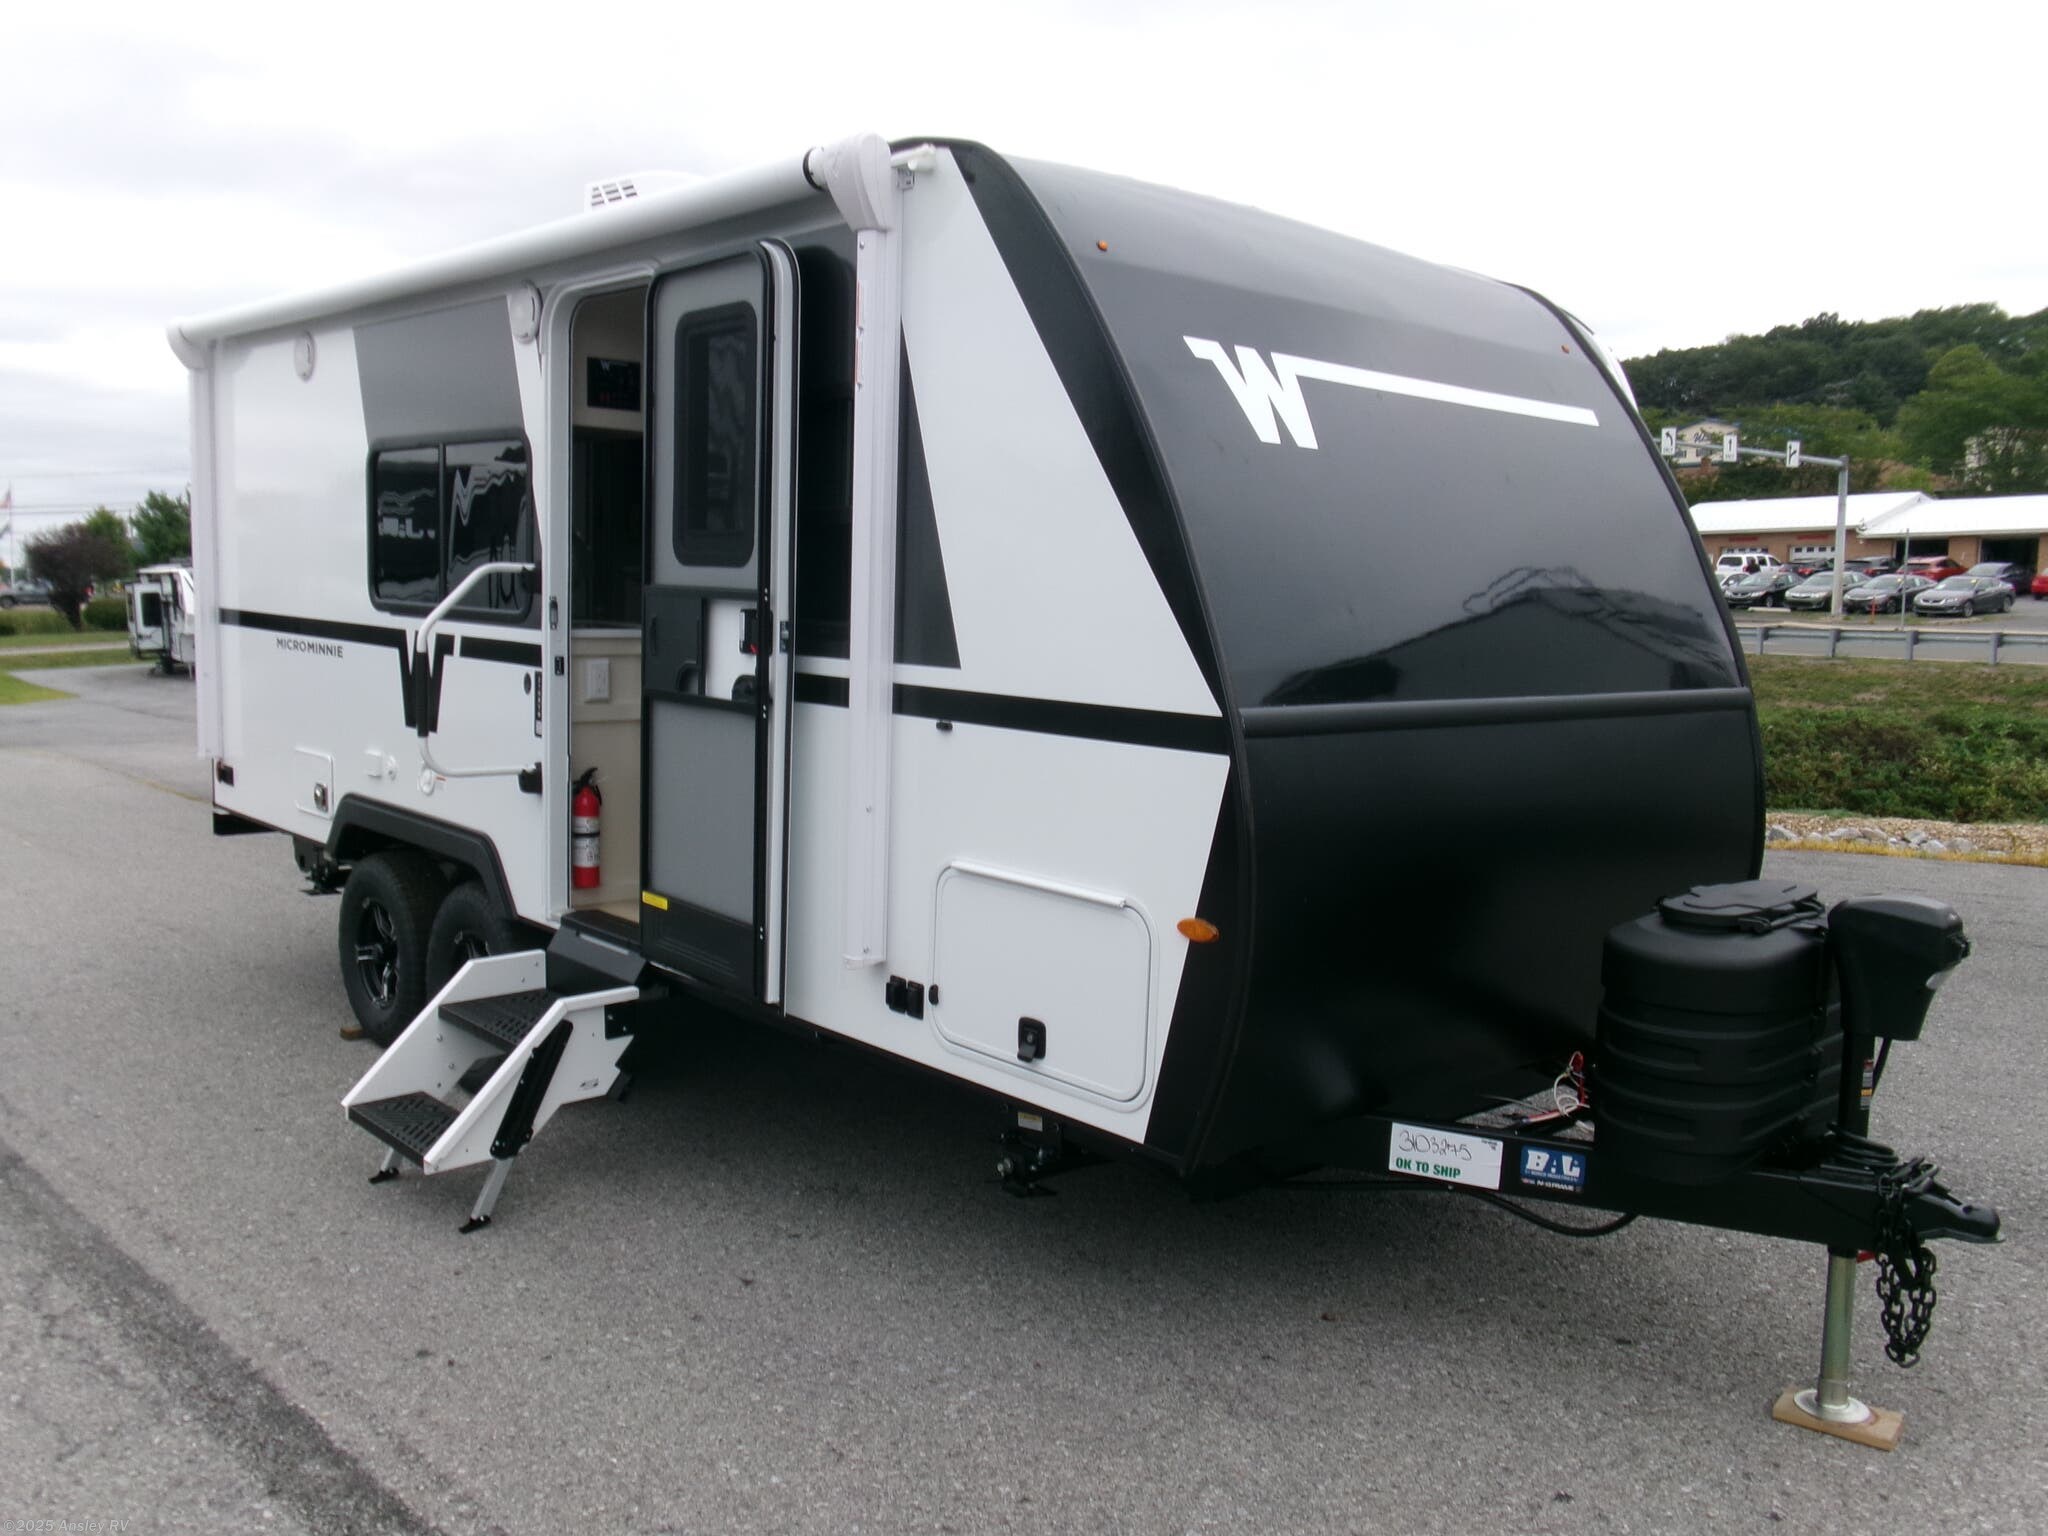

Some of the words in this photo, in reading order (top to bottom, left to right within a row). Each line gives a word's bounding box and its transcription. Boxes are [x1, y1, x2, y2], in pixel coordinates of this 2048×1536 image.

[276, 637, 344, 659] MICROMINNIE
[1395, 1156, 1412, 1171] OK
[1415, 1161, 1430, 1174] TO
[1432, 1163, 1462, 1179] SHIP
